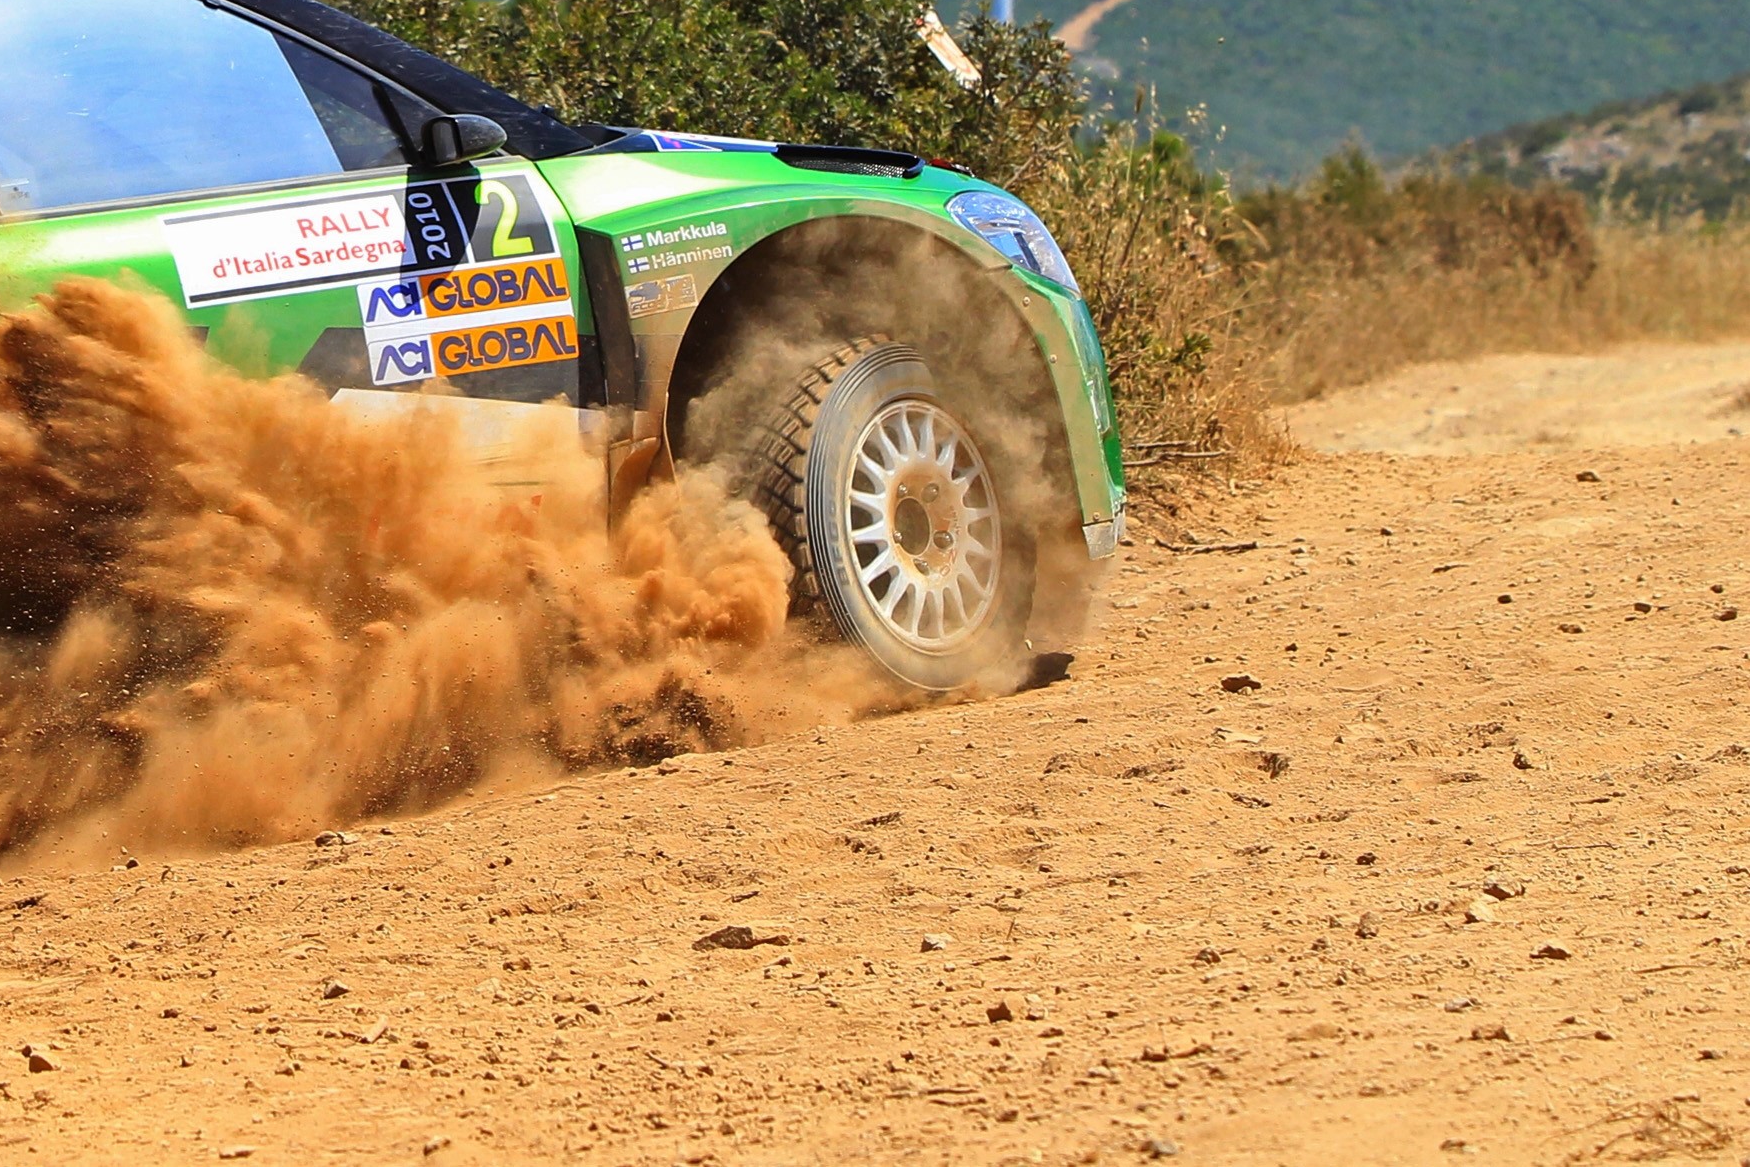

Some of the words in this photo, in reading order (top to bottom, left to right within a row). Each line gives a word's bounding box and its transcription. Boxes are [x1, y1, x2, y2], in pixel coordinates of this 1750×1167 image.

[296, 207, 390, 239] RALLY
[408, 192, 450, 260] 2010
[475, 180, 534, 257] 2
[646, 222, 727, 247] Markkula
[295, 239, 407, 266] Sardegna
[652, 245, 733, 269] Hänninen
[428, 263, 567, 310] GLOBAL
[438, 322, 577, 367] GLOBAL
